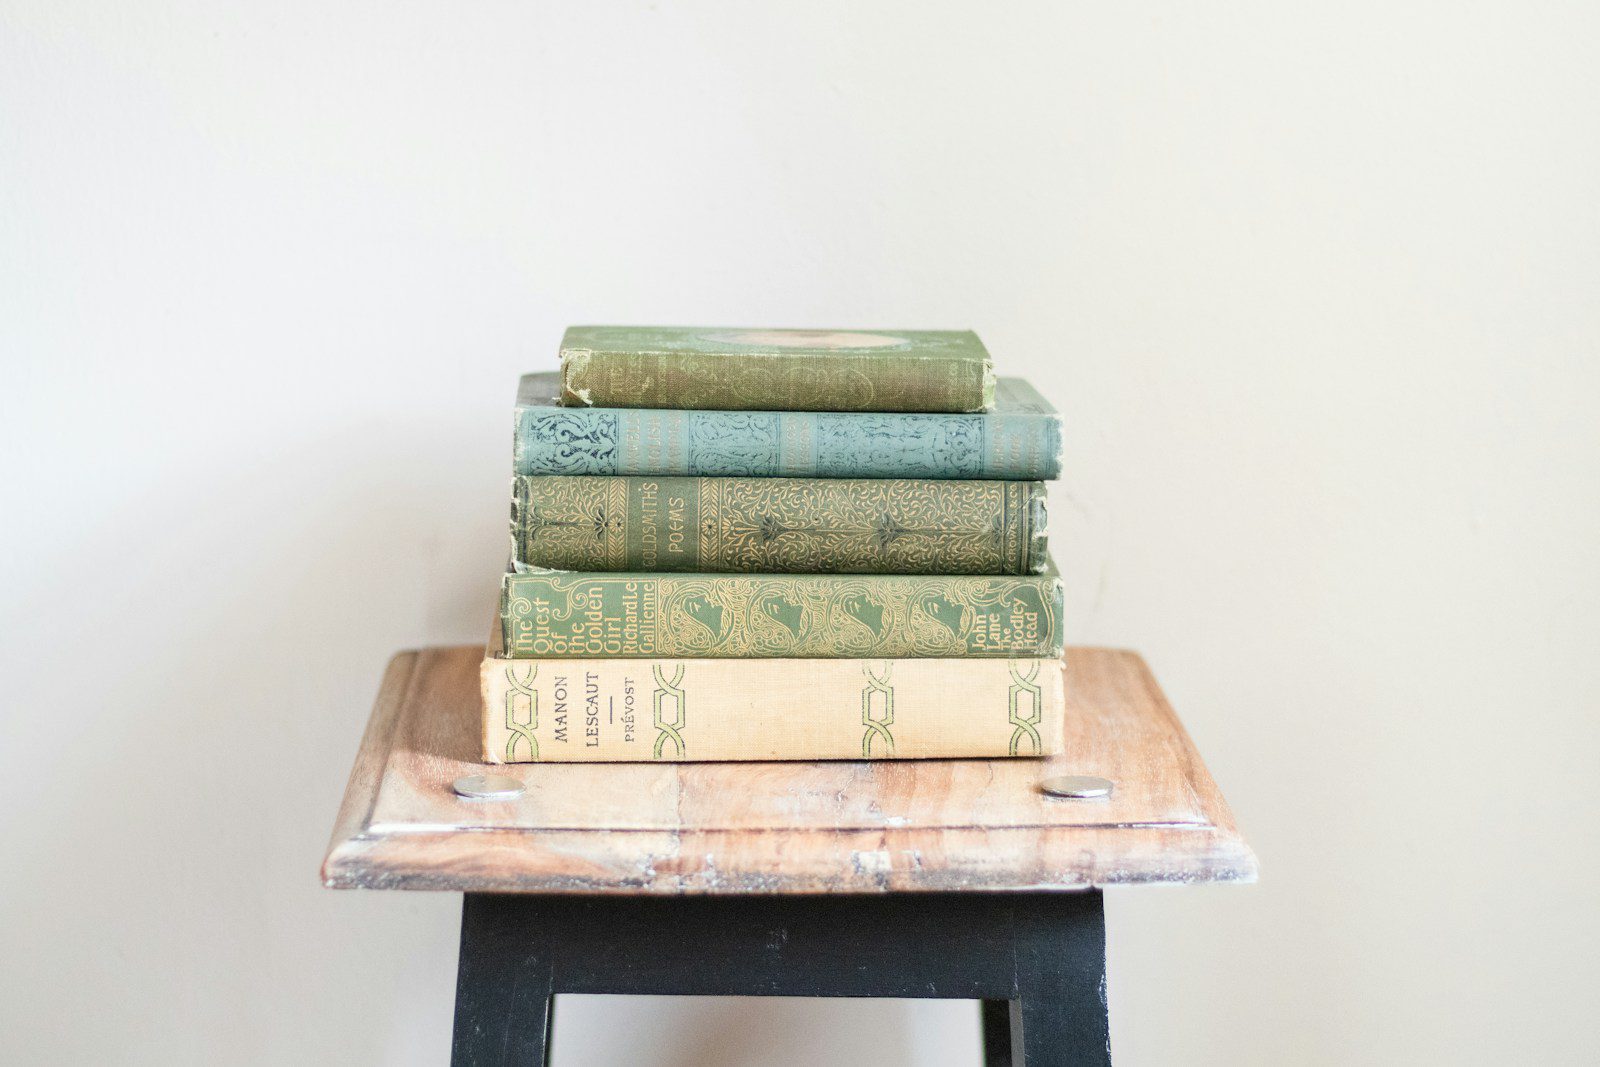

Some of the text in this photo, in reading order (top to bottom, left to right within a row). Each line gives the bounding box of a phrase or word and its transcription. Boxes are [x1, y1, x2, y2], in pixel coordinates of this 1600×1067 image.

[668, 497, 685, 553] POEMS
[516, 620, 533, 652] The
[533, 597, 553, 654] Quest
[551, 631, 568, 654] of
[568, 622, 585, 654] the
[585, 586, 603, 654] Golden
[604, 617, 622, 654] Girl
[623, 601, 638, 654] Richard
[638, 582, 656, 654] Gallienne
[972, 614, 987, 651] John
[986, 613, 1001, 650] Lane
[1000, 628, 1011, 650] The
[1009, 597, 1028, 650] Bodley
[1024, 612, 1038, 650] Head
[555, 676, 567, 743] MANON
[586, 672, 598, 747] LESCAUT
[621, 677, 634, 742] PRÉVOST
